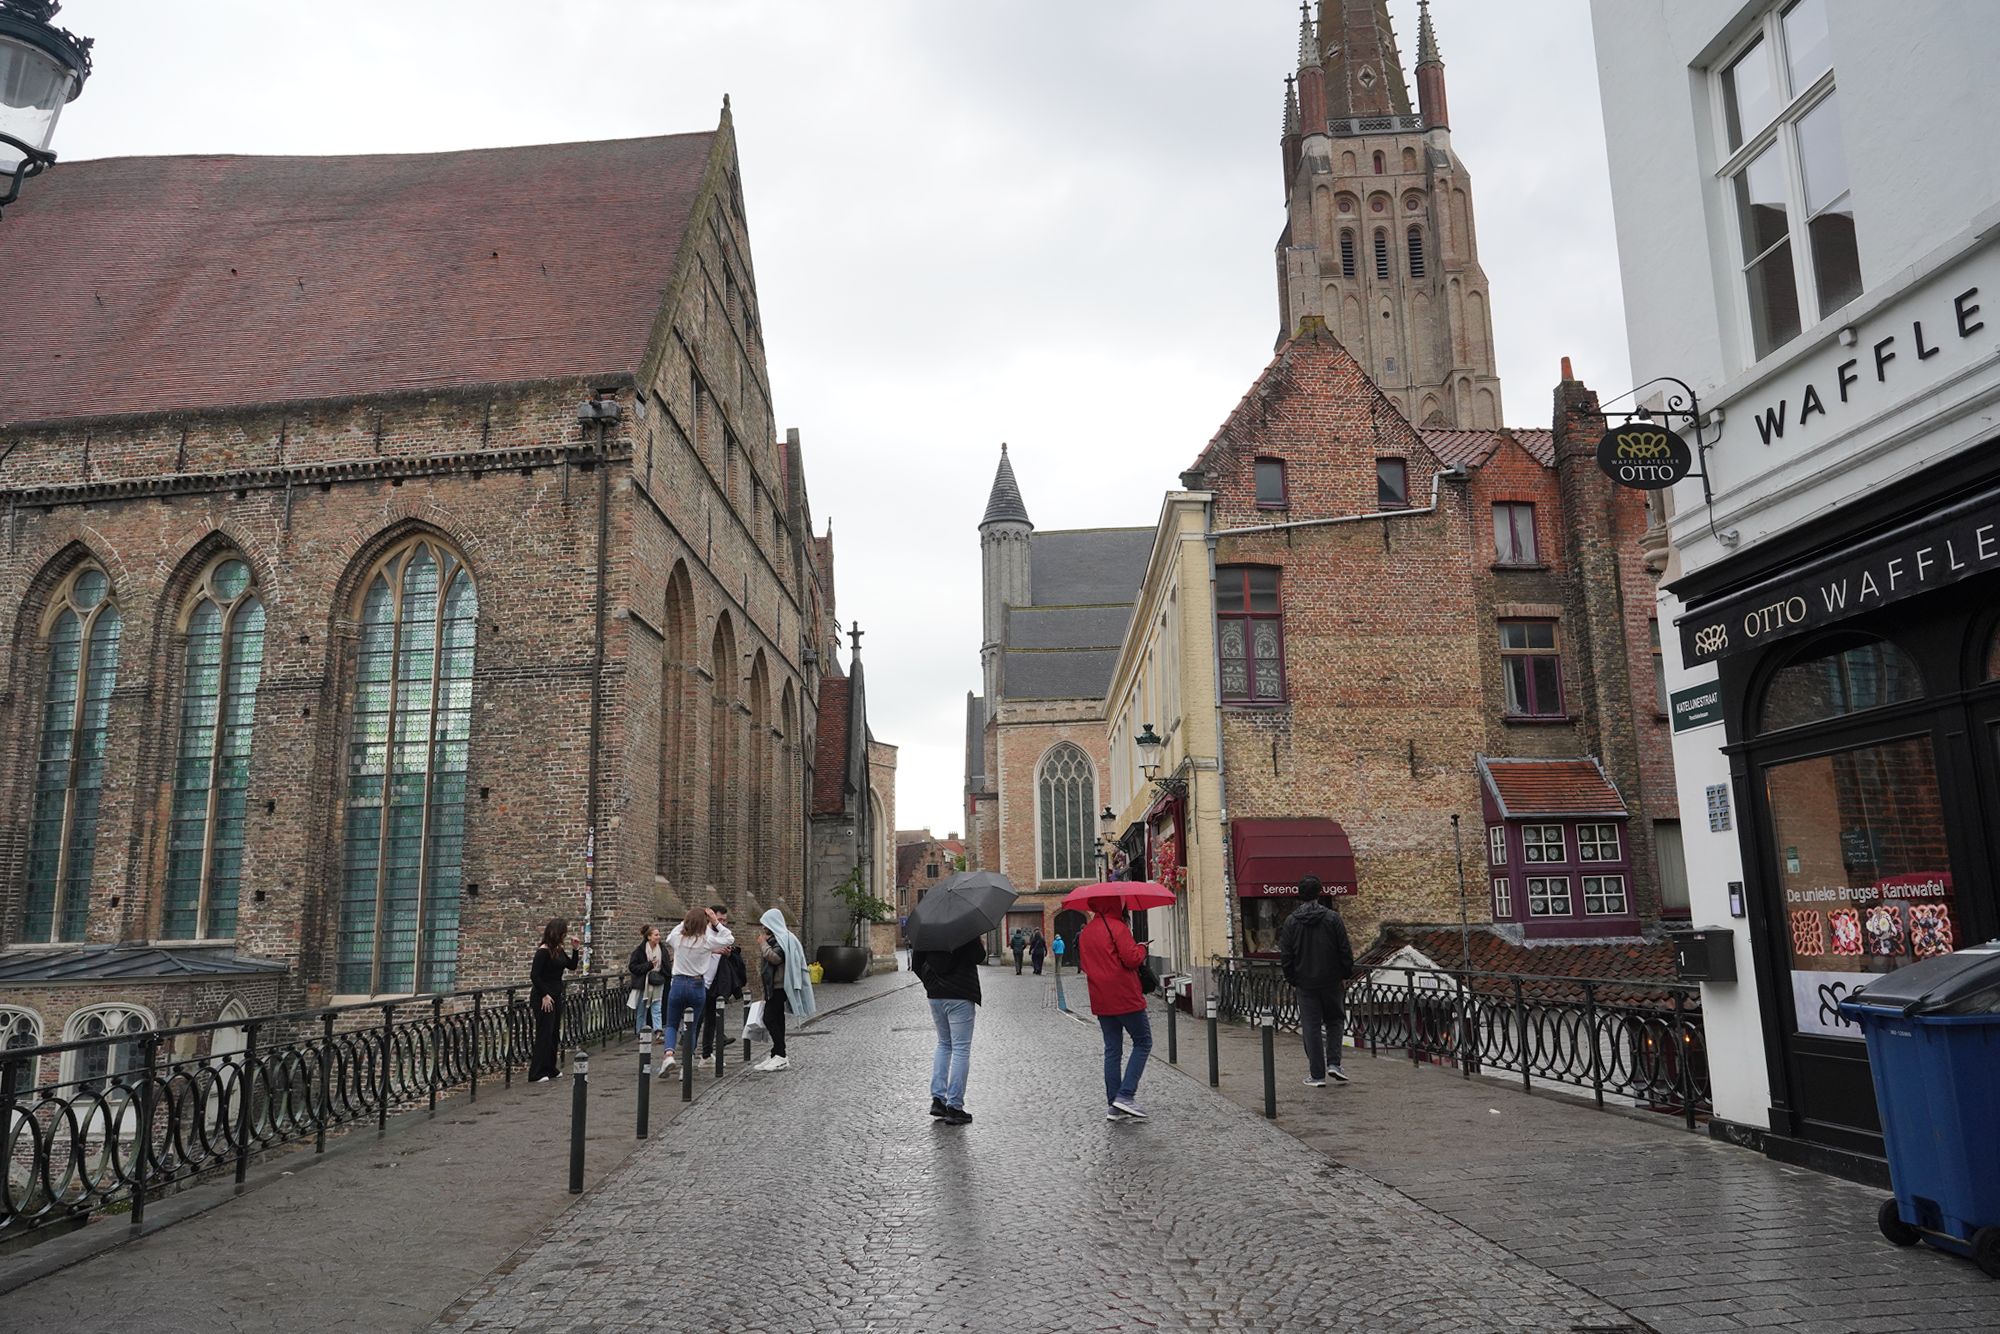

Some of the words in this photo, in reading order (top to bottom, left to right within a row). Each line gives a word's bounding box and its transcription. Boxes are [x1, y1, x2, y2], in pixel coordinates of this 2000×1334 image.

[1754, 286, 1984, 446] WAFFLE
[1620, 465, 1674, 481] OTTO
[1743, 596, 1807, 638] OTTO
[1820, 523, 1999, 613] WAFFLE
[1263, 883, 1299, 894] Serena
[1786, 888, 1801, 902] De
[1802, 886, 1836, 902] unieke
[1838, 885, 1879, 903] Brugse
[1881, 879, 1945, 899] Kantwafel
